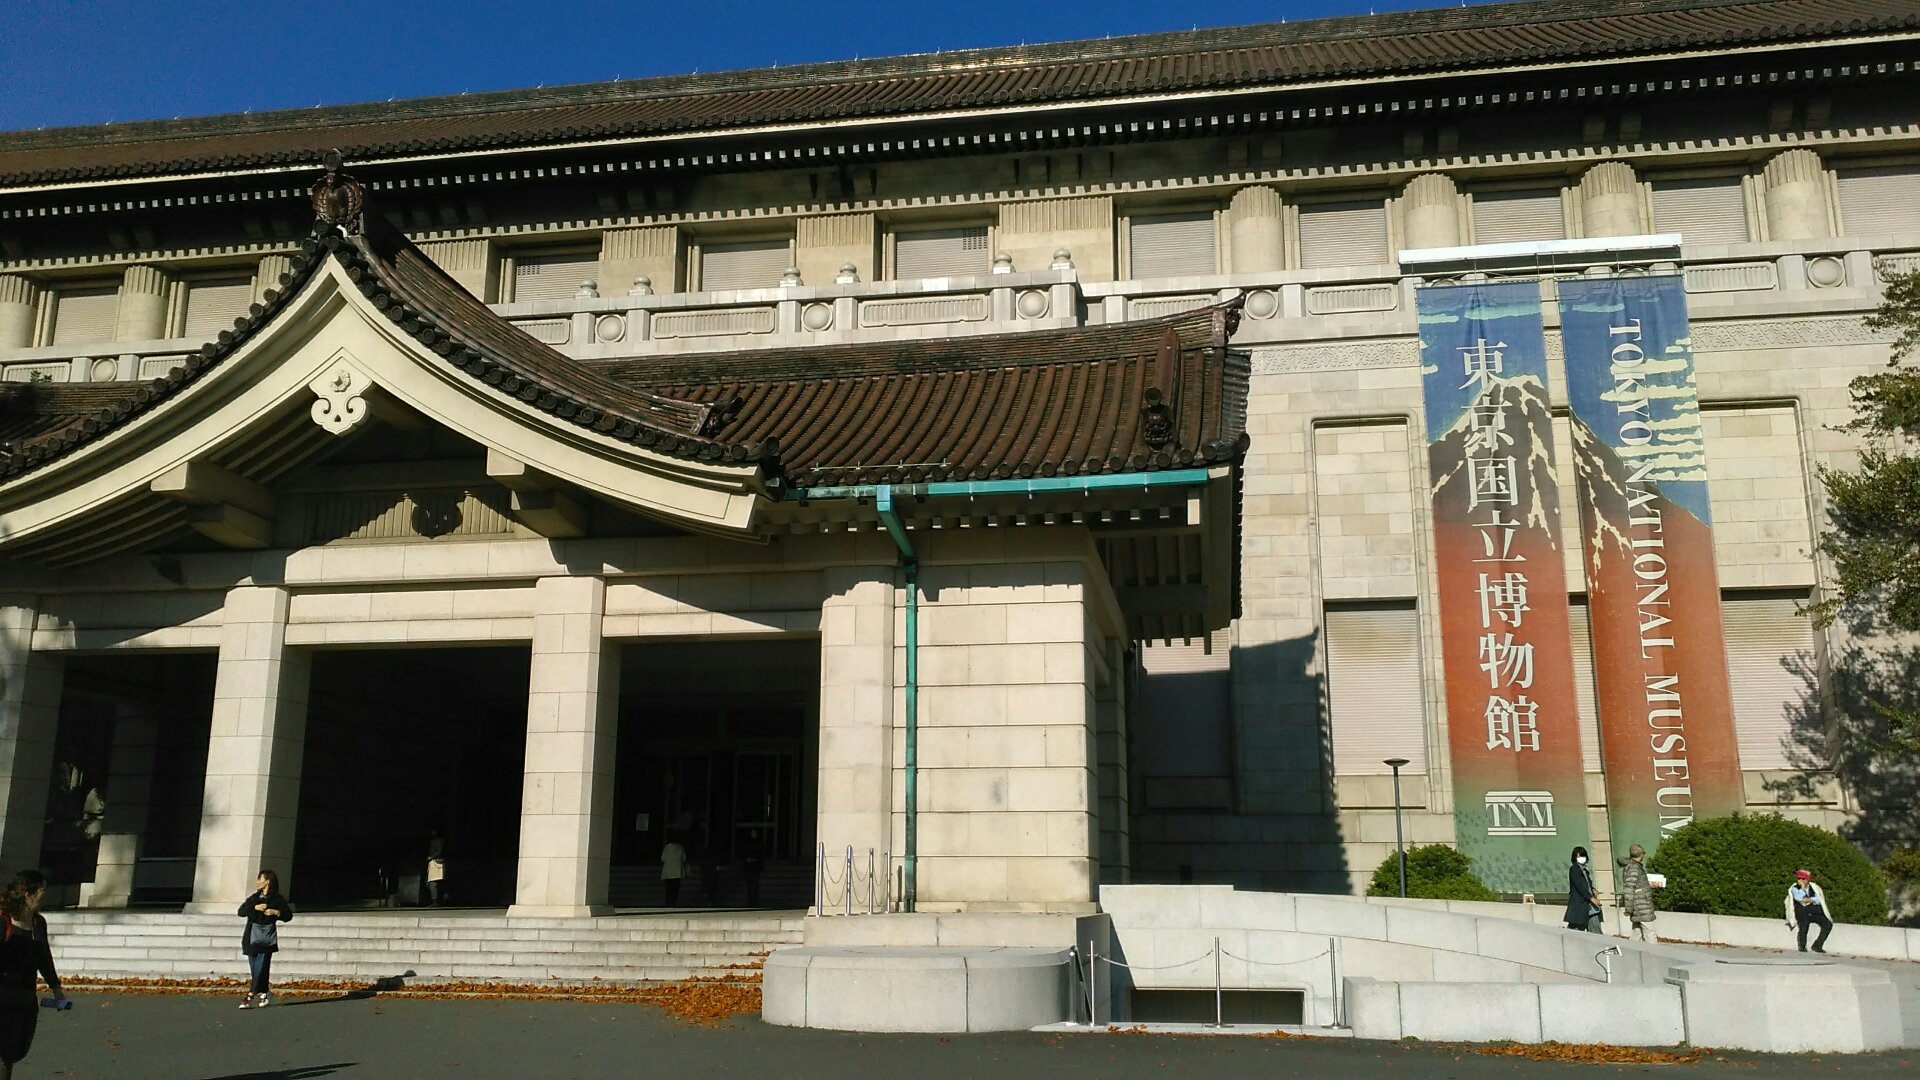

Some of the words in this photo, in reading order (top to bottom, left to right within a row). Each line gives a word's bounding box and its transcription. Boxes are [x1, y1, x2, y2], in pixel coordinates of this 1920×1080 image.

[1607, 318, 1653, 447] TOKYO
[1456, 338, 1541, 752] 東京国立博物館
[1623, 460, 1676, 660] NATIONAL
[1485, 802, 1556, 827] TNM
